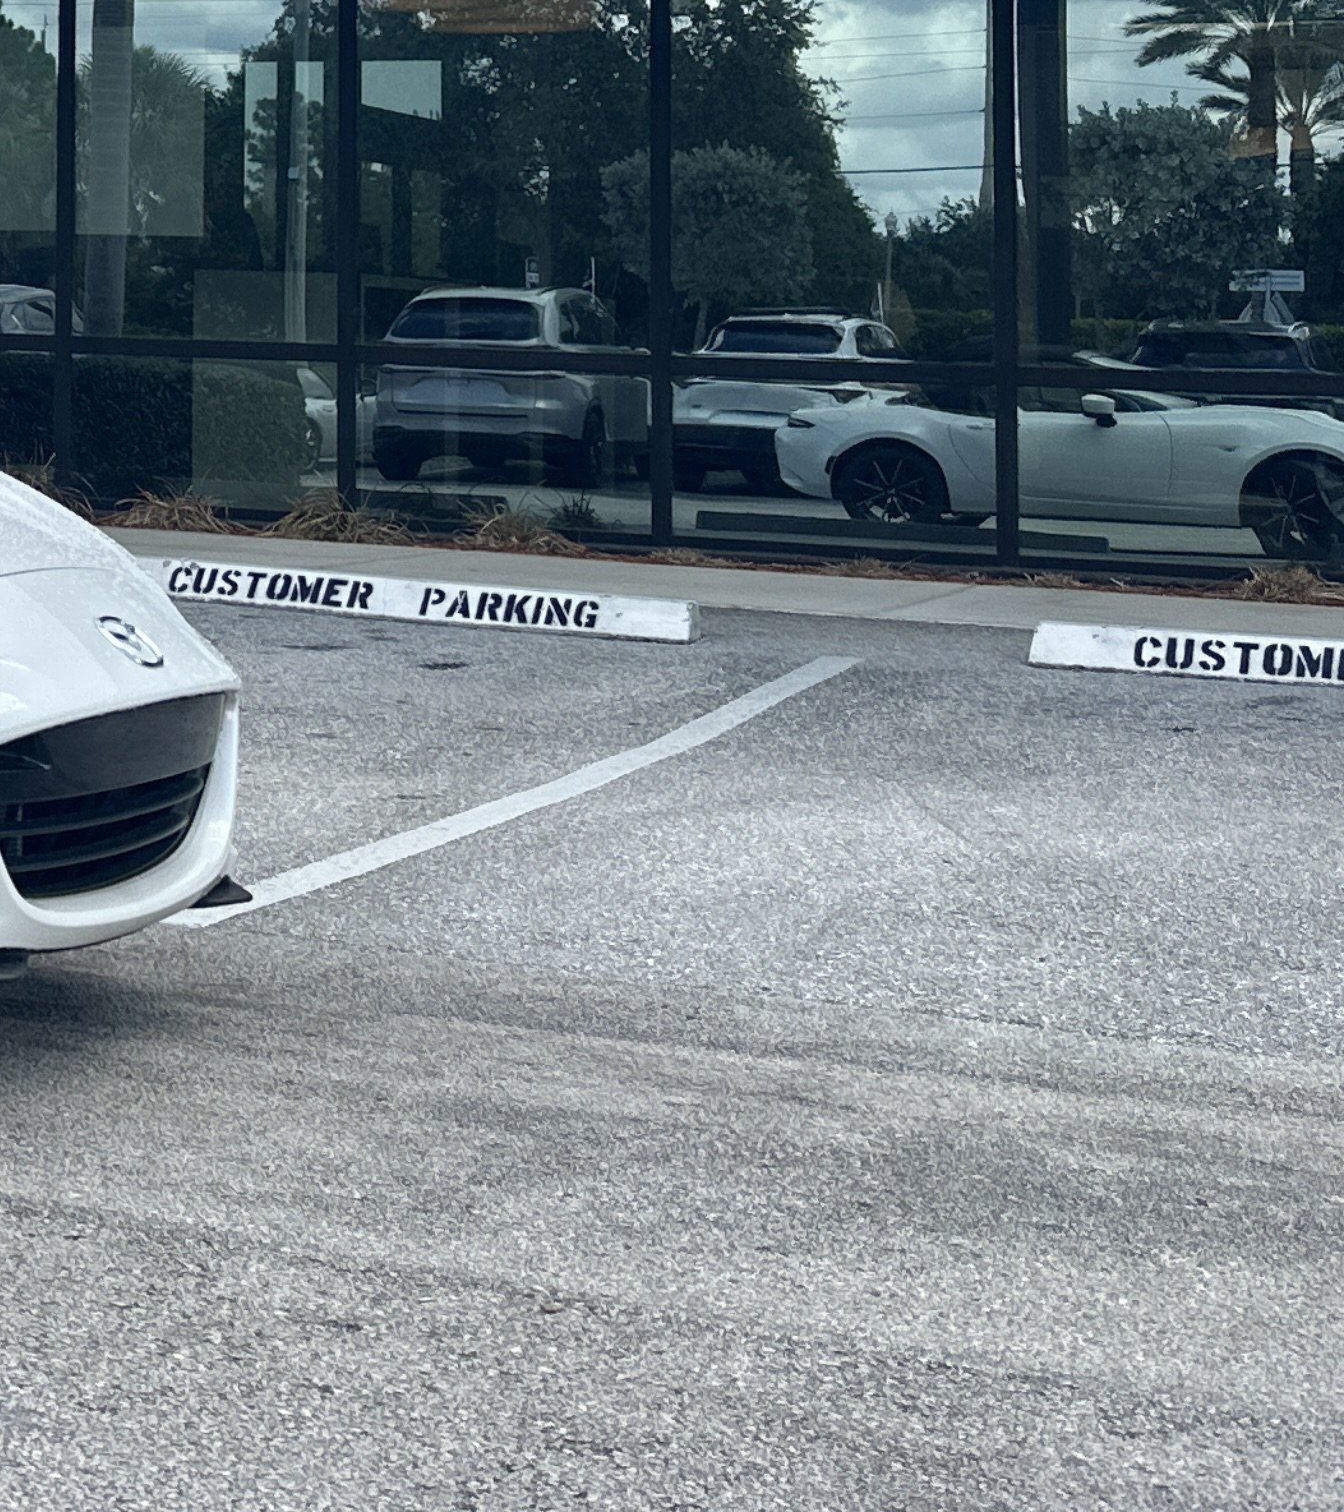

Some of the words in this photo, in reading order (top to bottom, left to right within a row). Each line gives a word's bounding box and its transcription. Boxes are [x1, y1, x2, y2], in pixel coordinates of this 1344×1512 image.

[168, 566, 374, 609] CUSTOMER
[419, 587, 600, 628] PARKING
[1133, 636, 1344, 680] CUSTOM
